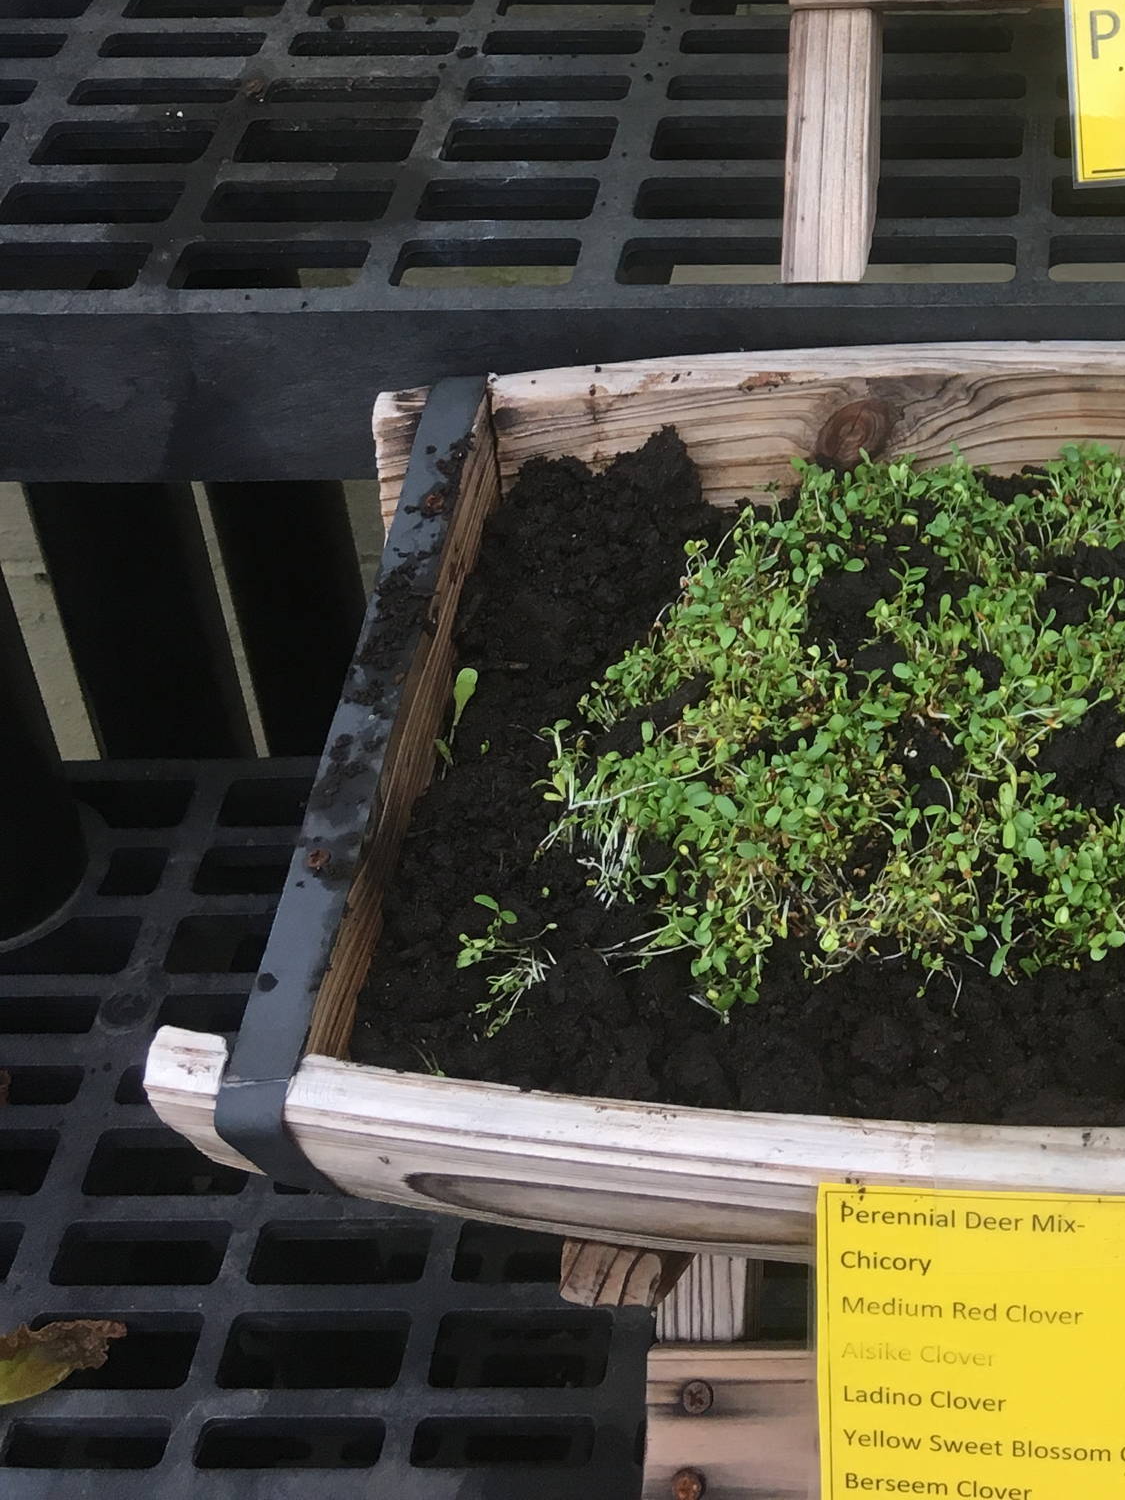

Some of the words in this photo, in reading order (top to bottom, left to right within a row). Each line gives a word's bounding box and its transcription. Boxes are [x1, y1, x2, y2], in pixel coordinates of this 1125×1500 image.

[841, 1203, 955, 1228] Perennial
[965, 1211, 1023, 1232] Deer
[1032, 1214, 1085, 1234] Mix-
[840, 1250, 931, 1276] Chicory
[842, 1296, 943, 1318] Medium
[952, 1301, 997, 1322] Red
[1006, 1304, 1084, 1325] Clover
[841, 1342, 912, 1362] Alsike
[920, 1345, 995, 1367] Clover
[843, 1385, 922, 1407] Ladino
[930, 1390, 1007, 1412] Clover
[843, 1428, 922, 1451] Yellow
[929, 1434, 1003, 1457] Sweet
[1012, 1440, 1112, 1462] Blossom
[845, 1472, 948, 1496] Berseem
[956, 1480, 1033, 1500] Clover
